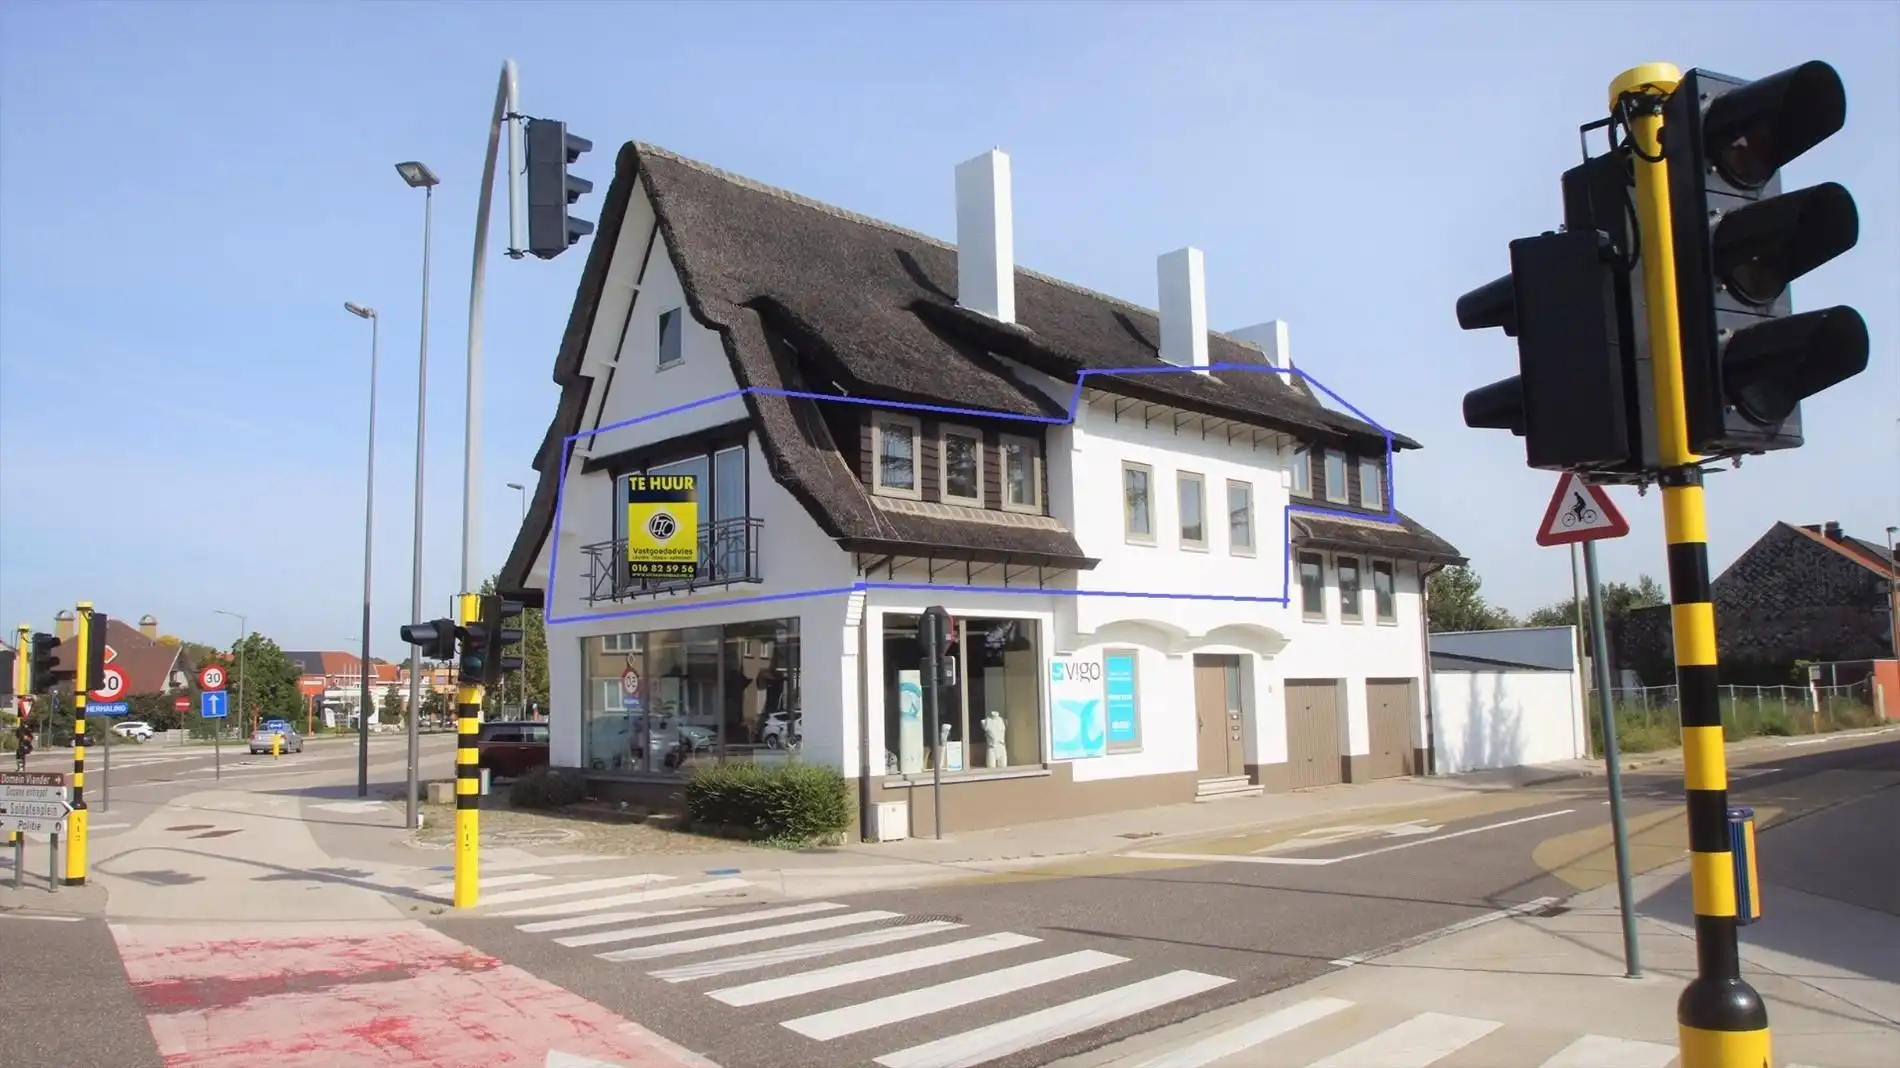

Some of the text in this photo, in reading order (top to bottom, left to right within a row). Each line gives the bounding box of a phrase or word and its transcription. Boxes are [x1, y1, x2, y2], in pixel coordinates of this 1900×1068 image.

[629, 476, 694, 491] TE HUUR
[633, 547, 693, 556] Vastgoedadvies
[631, 564, 694, 573] 016 82 59 56
[206, 673, 220, 683] 30
[86, 704, 127, 713] HERHALING
[1, 773, 25, 784] Domein
[10, 802, 57, 816] Soldatenplein
[17, 820, 41, 831] Politie
